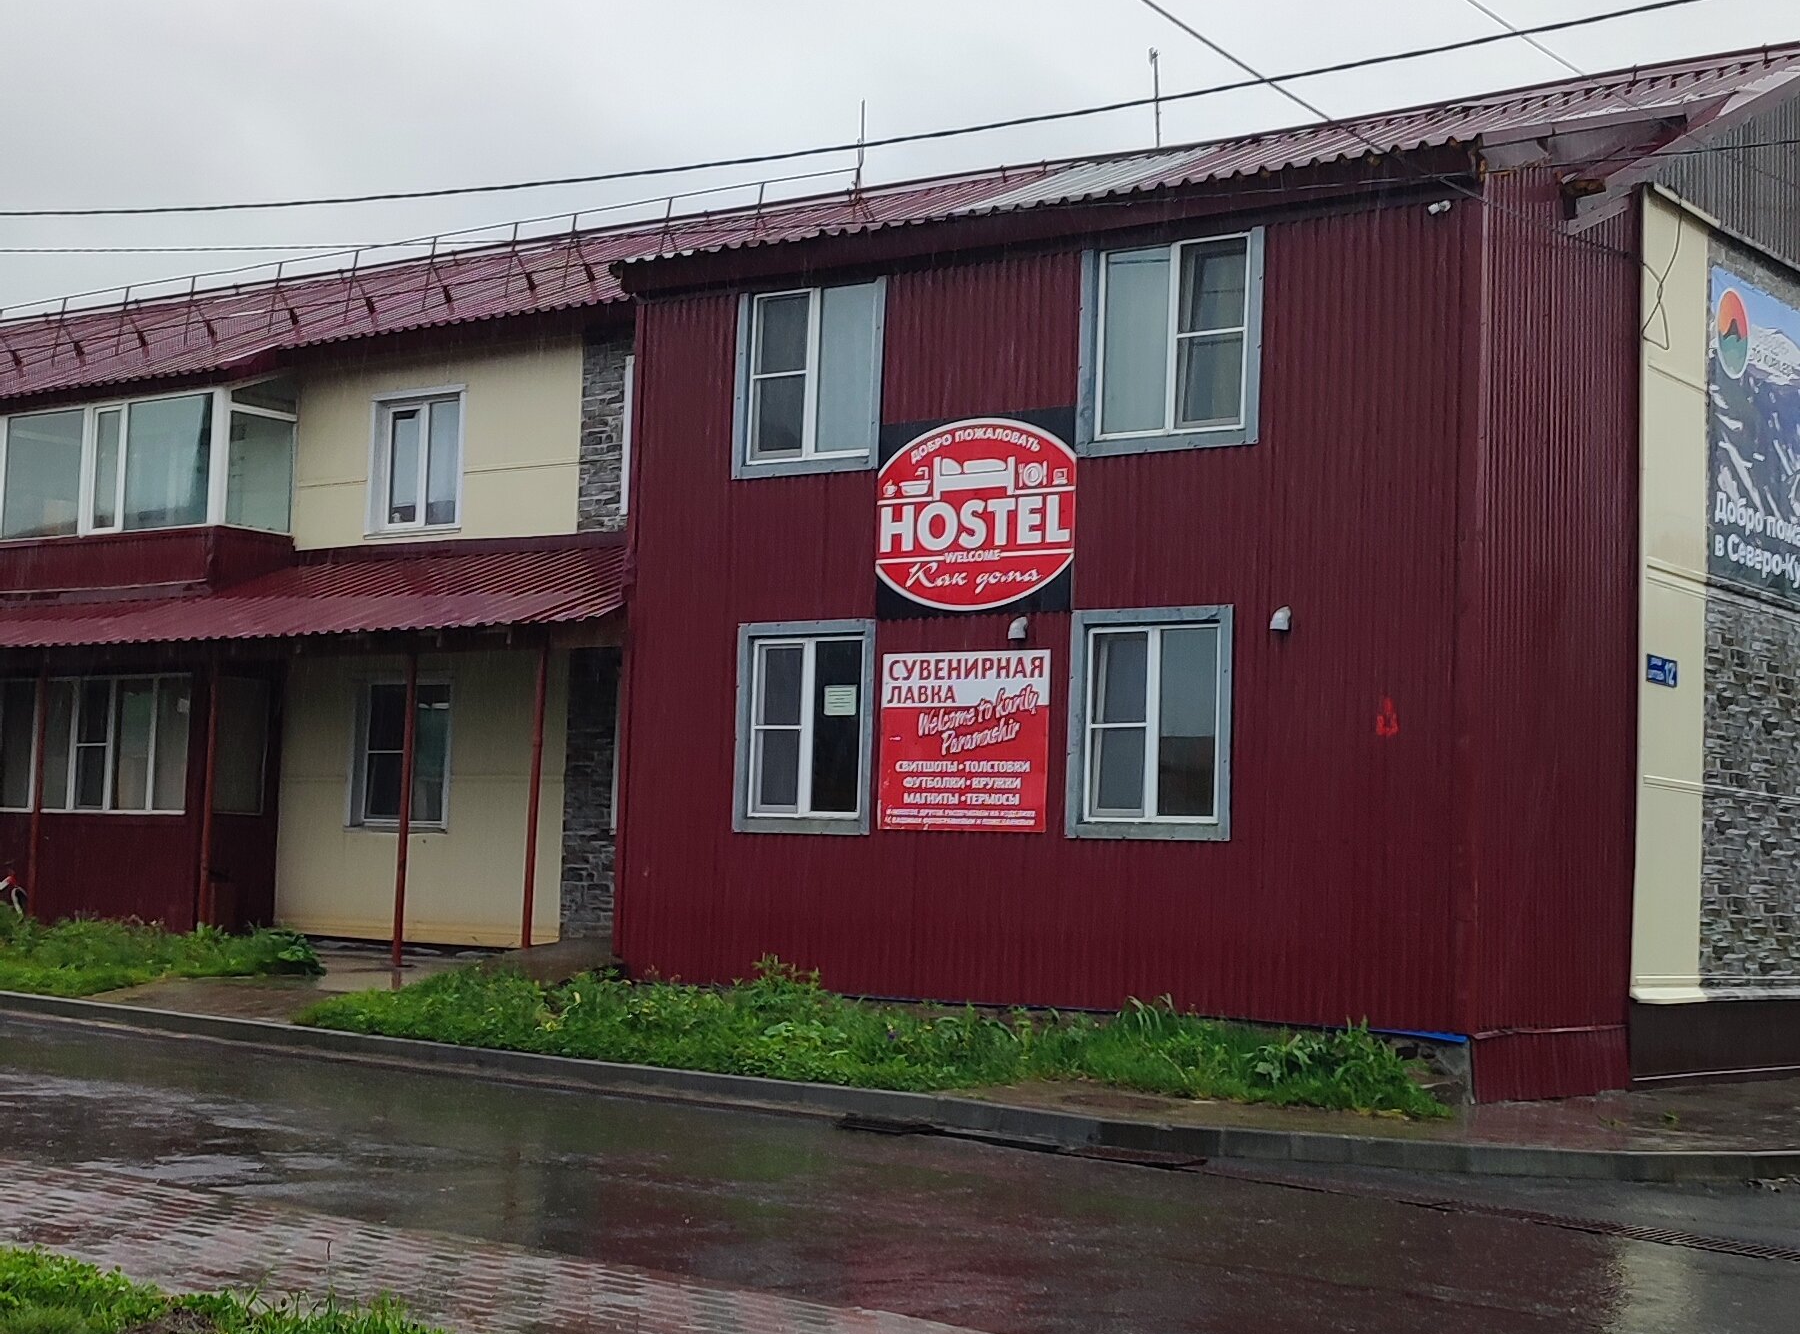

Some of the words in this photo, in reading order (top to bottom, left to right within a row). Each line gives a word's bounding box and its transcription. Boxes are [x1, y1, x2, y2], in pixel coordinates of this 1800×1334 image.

[910, 433, 953, 465] ДОБРО
[955, 427, 1041, 452] ПОЖАЛОВАТЬ
[879, 495, 1071, 553] HOSTEL
[1714, 491, 1764, 537] Добро
[944, 549, 1001, 563] WELCOME
[1714, 534, 1725, 557] в
[905, 562, 969, 590] Как
[974, 568, 1042, 595] дома
[888, 656, 1045, 681] СУВЕНИРНАЯ
[1665, 661, 1676, 685] 12
[887, 685, 957, 704] ЛАВКА
[918, 708, 977, 737] Welcome
[977, 698, 993, 723] to
